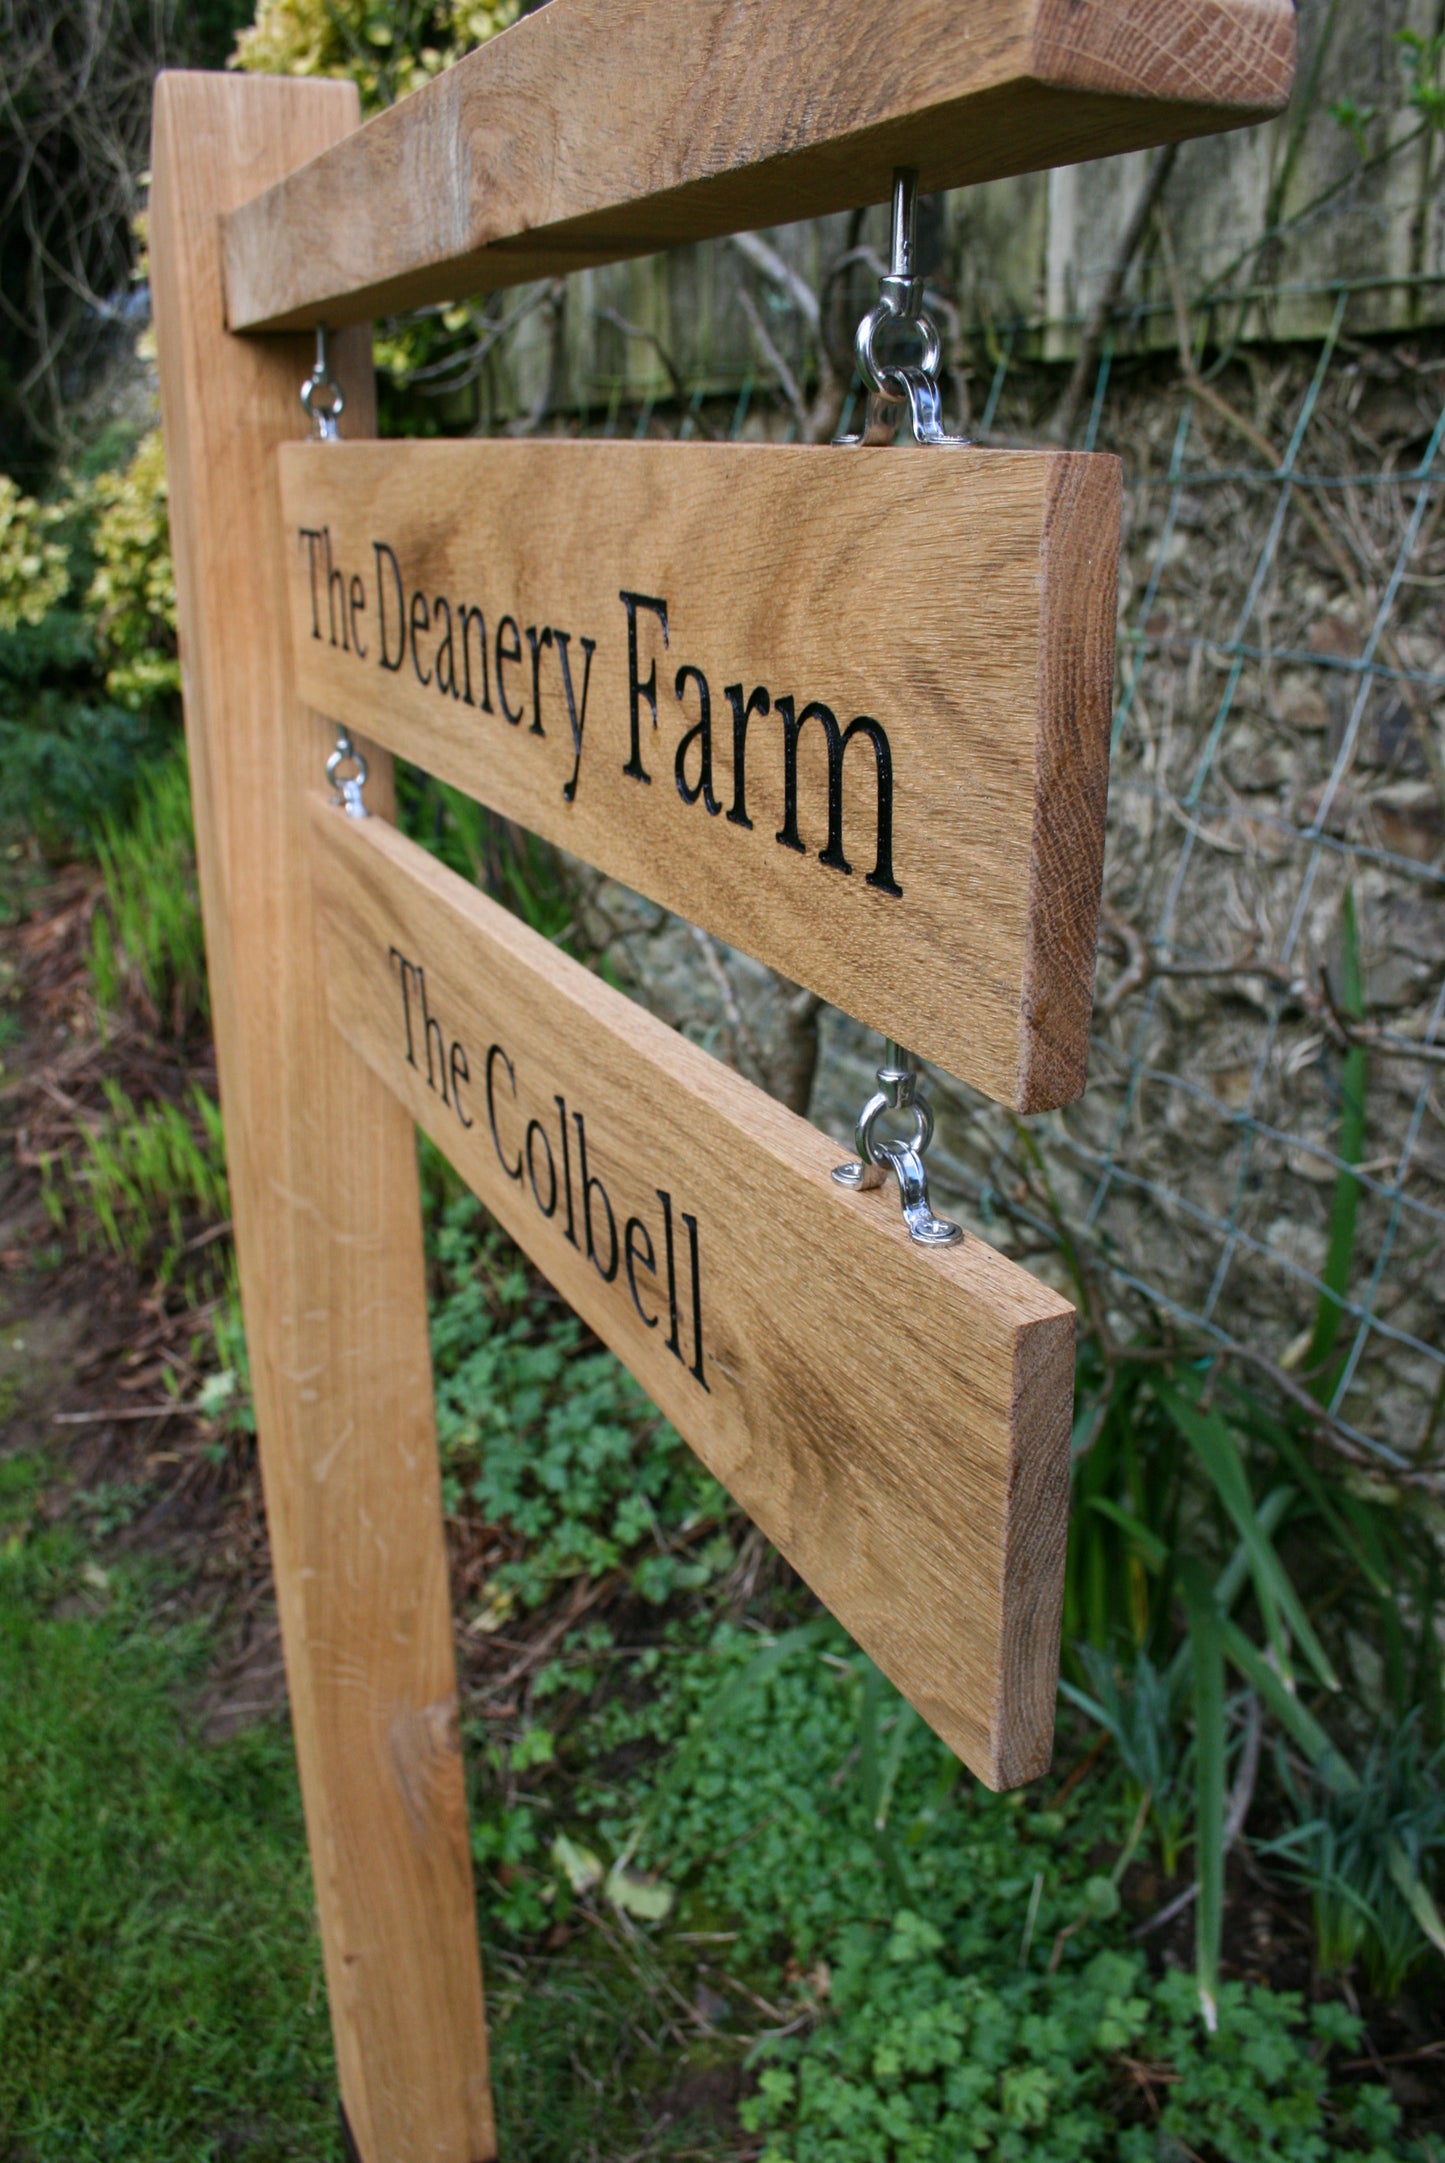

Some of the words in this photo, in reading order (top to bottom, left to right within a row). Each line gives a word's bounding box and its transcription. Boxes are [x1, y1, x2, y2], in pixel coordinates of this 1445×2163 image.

[299, 525, 367, 659] The
[373, 541, 596, 802] Deanery
[619, 590, 903, 898] Farm
[389, 945, 473, 1128] The
[486, 1043, 711, 1393] Colbell
